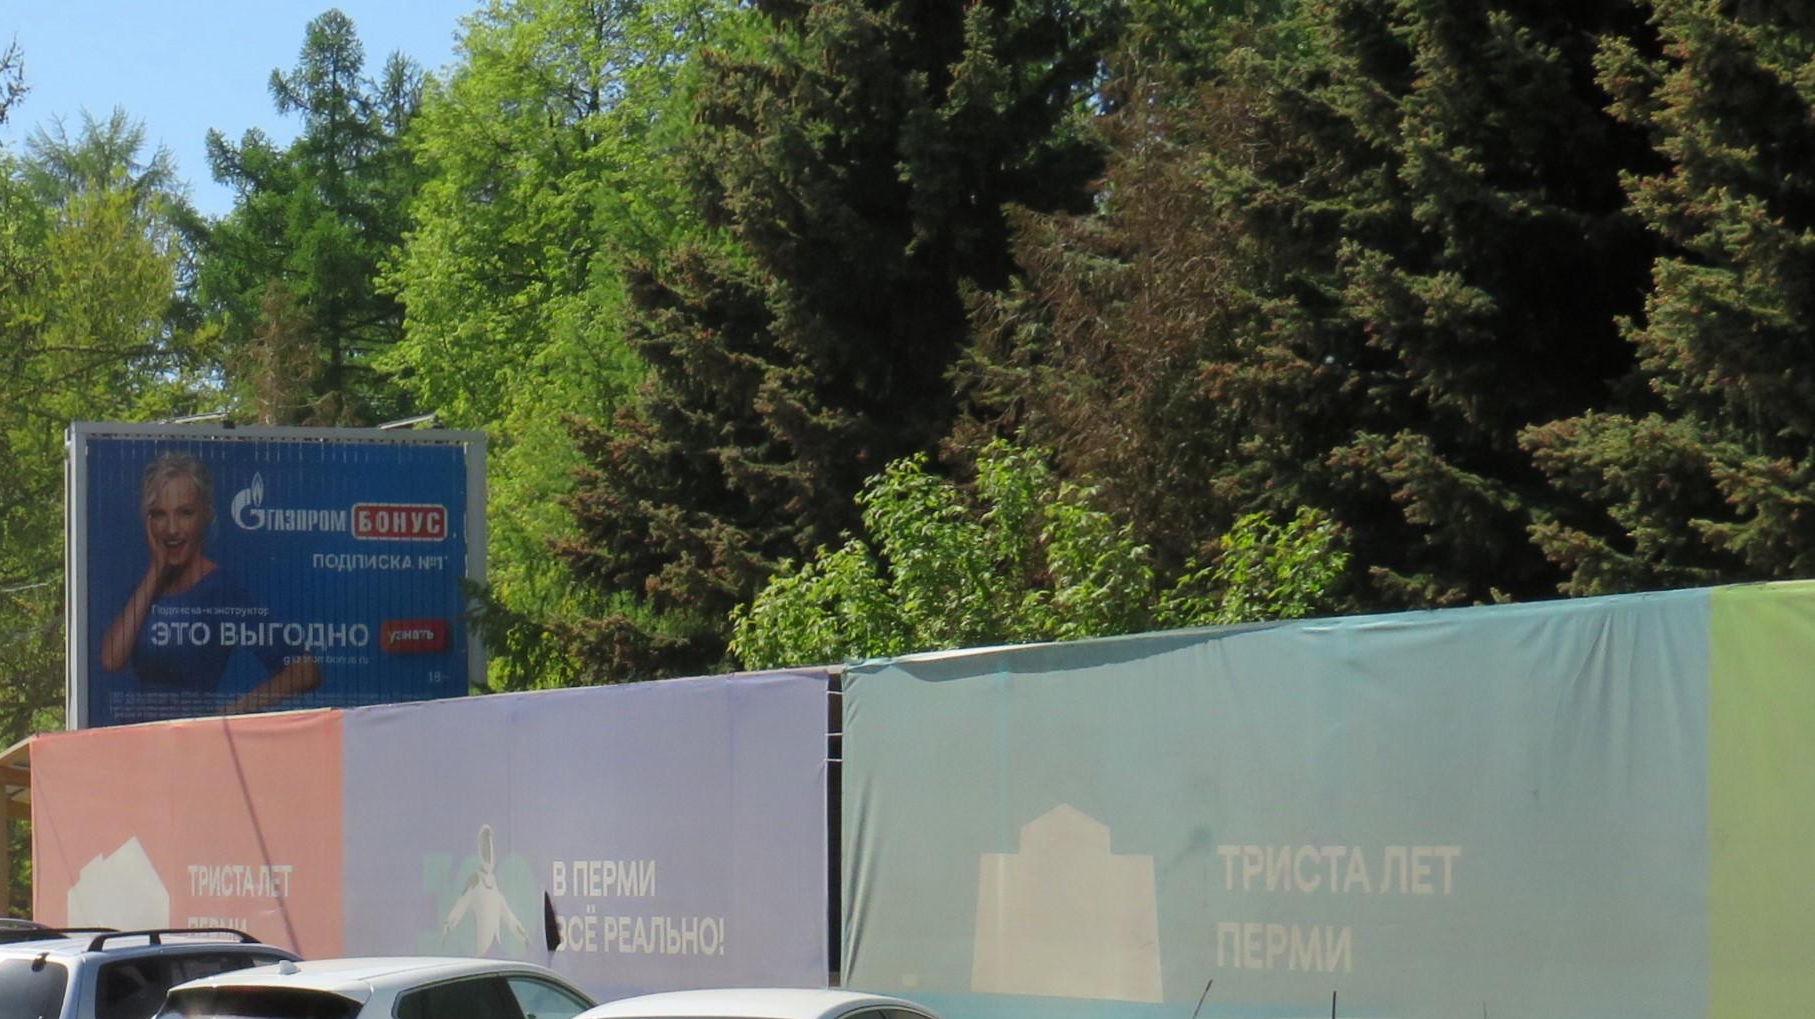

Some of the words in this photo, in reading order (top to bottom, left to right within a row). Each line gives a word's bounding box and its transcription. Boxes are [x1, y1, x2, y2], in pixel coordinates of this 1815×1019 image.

[266, 508, 347, 532] ГАЗПРОМ
[358, 510, 441, 534] БОНУС
[312, 553, 413, 573] ПОДПИСКА
[151, 621, 212, 647] ЭТО
[219, 621, 370, 652] ВЫГОДНО
[388, 629, 435, 644] узнать
[187, 865, 255, 897] ТРИСТА
[258, 865, 294, 897] ЛЕТ
[552, 860, 567, 897] В
[572, 860, 656, 897] ПЕРМИ
[1217, 844, 1372, 894] ТРИСТА
[1380, 846, 1462, 896] ЛЕТ
[557, 903, 598, 952] ВСЁ
[604, 916, 726, 957] РЕАЛЬНО!
[1217, 921, 1354, 973] ПЕРМИ
